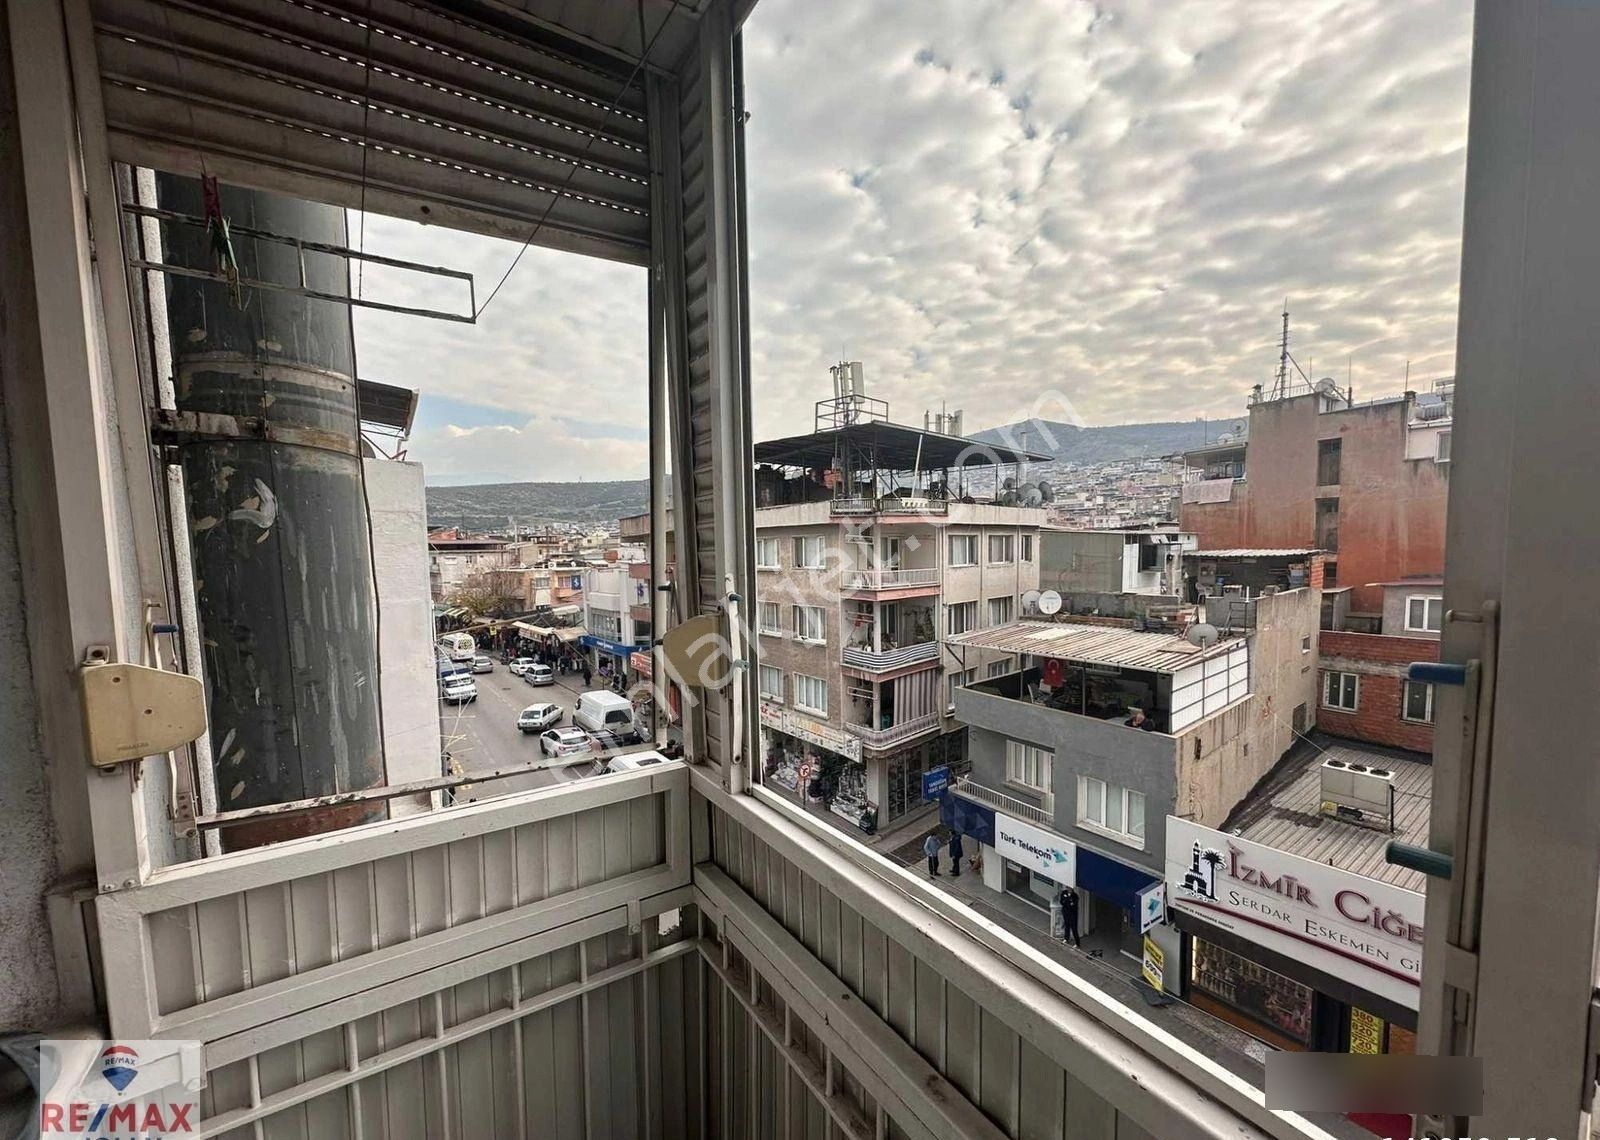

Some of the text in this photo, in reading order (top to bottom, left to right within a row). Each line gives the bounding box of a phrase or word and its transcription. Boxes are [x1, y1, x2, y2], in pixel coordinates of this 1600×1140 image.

[1000, 831, 1052, 861] Türk Telekom
[1227, 841, 1318, 908] İZMİR
[1229, 890, 1291, 923] SERDAR
[1306, 918, 1389, 961] ESKEMEN
